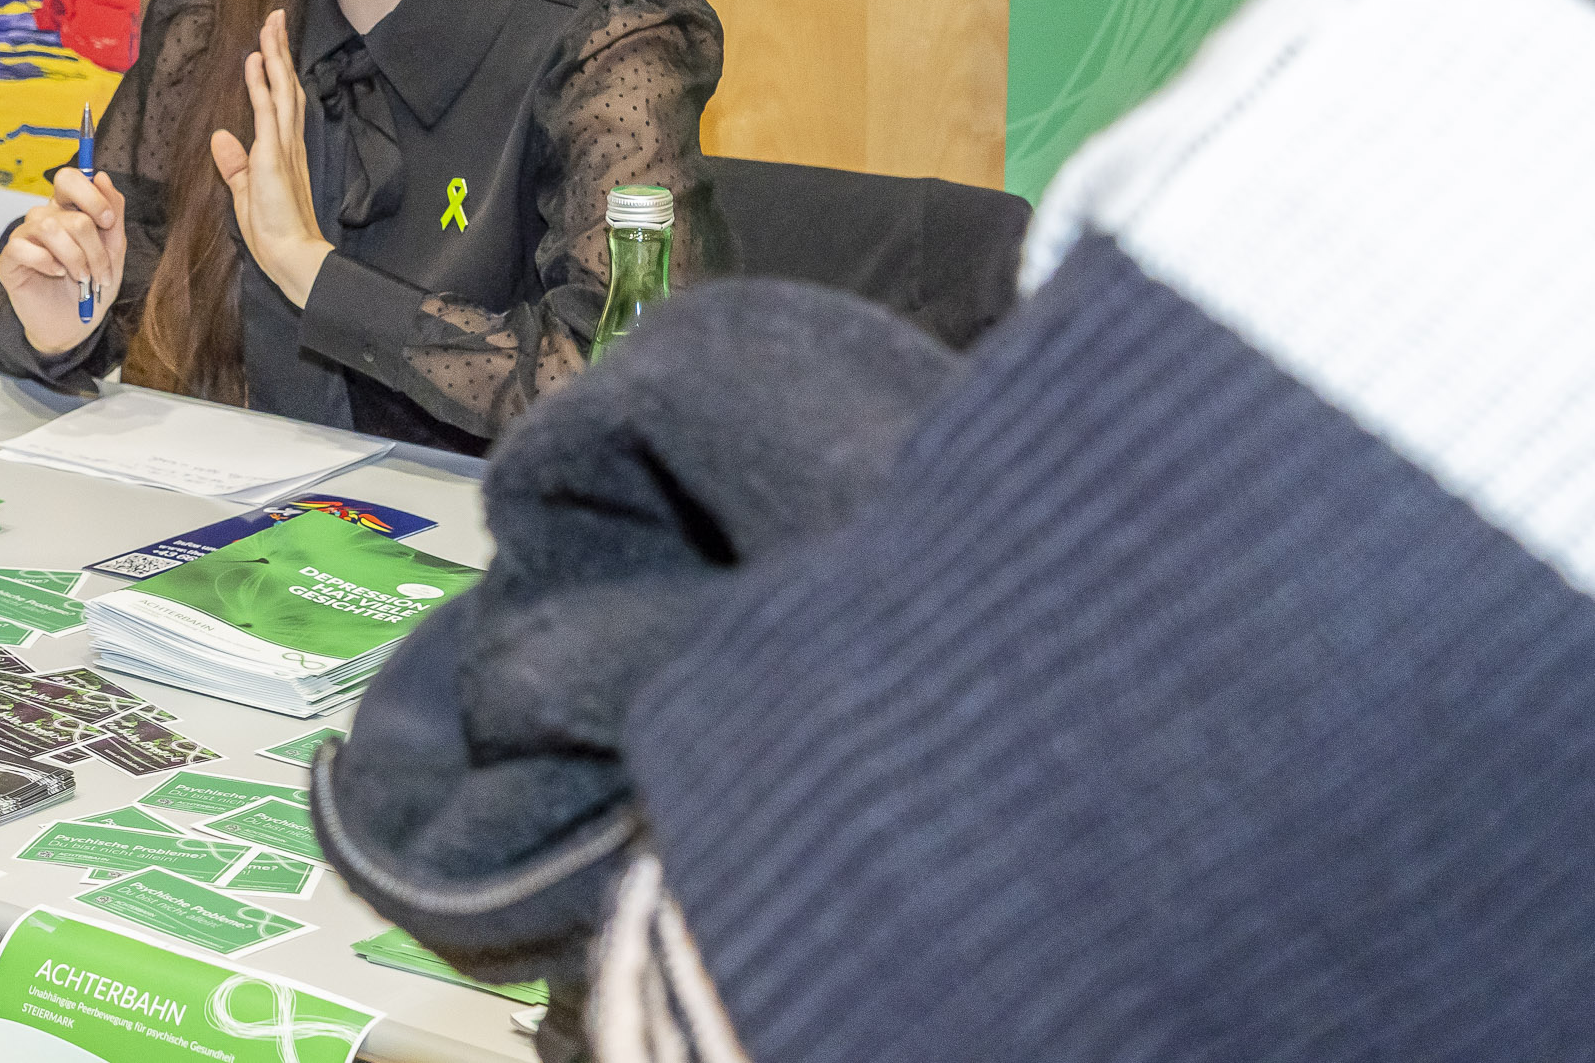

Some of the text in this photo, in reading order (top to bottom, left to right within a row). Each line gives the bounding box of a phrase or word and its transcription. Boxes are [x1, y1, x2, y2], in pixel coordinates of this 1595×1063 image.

[288, 585, 403, 623] GESICHTER
[298, 566, 431, 611] DEPRESSION
[312, 584, 419, 617] HAT VIELE
[174, 784, 247, 800] Psychische
[47, 840, 67, 848] Du
[72, 841, 97, 851] bist
[100, 847, 134, 857] nicht
[54, 834, 207, 859] Psychische Probleme?
[129, 881, 254, 929] Psychische Probleme?
[35, 959, 187, 1026] ACHTERBAHN
[21, 1003, 75, 1029] STEIERMARK
[28, 985, 235, 1063] Unabhängige Peerbewegung für psychische Gesundheit
